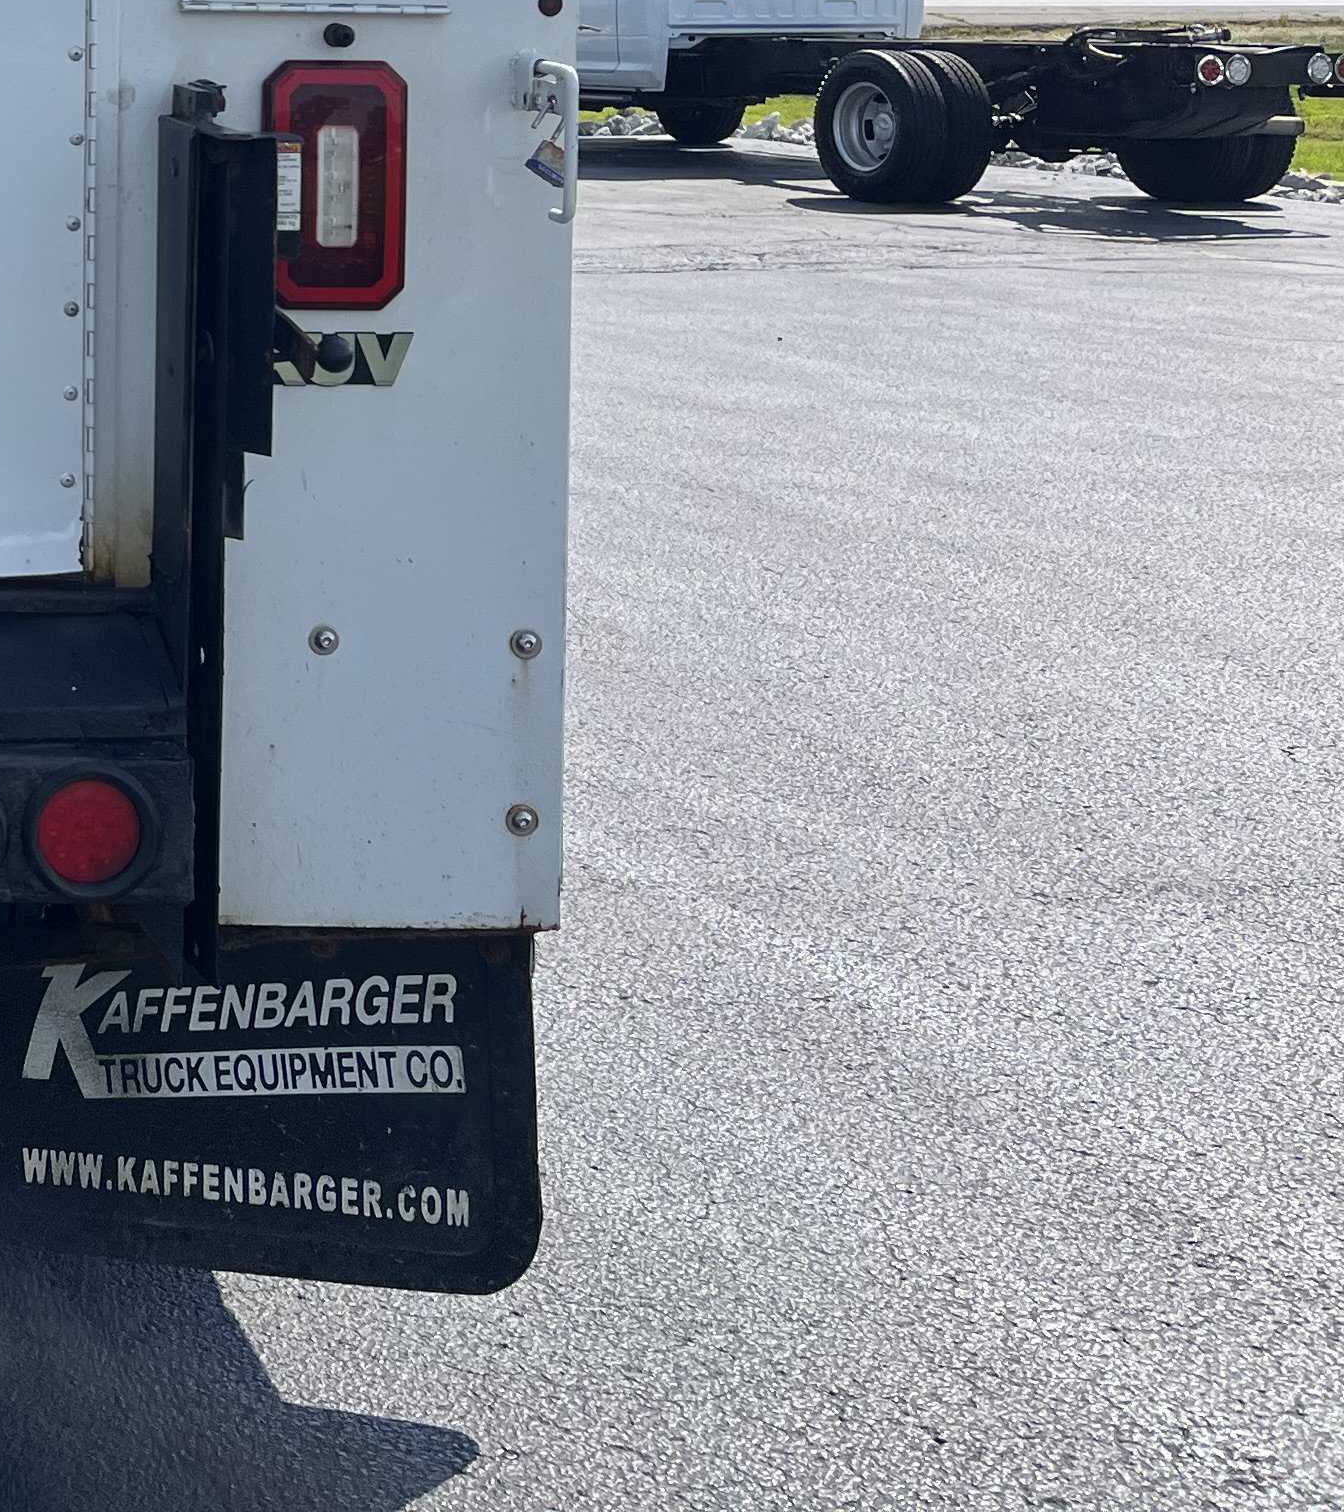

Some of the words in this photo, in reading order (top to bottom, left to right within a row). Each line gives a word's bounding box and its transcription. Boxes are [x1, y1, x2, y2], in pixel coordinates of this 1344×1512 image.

[22, 962, 458, 1099] KAFFENBARGER
[99, 1056, 209, 1094] TRUCK
[214, 1051, 397, 1093] EQUIPMENT
[406, 1049, 463, 1089] CO.
[22, 1147, 470, 1227] WWW.KAFFENBARGER.COM
